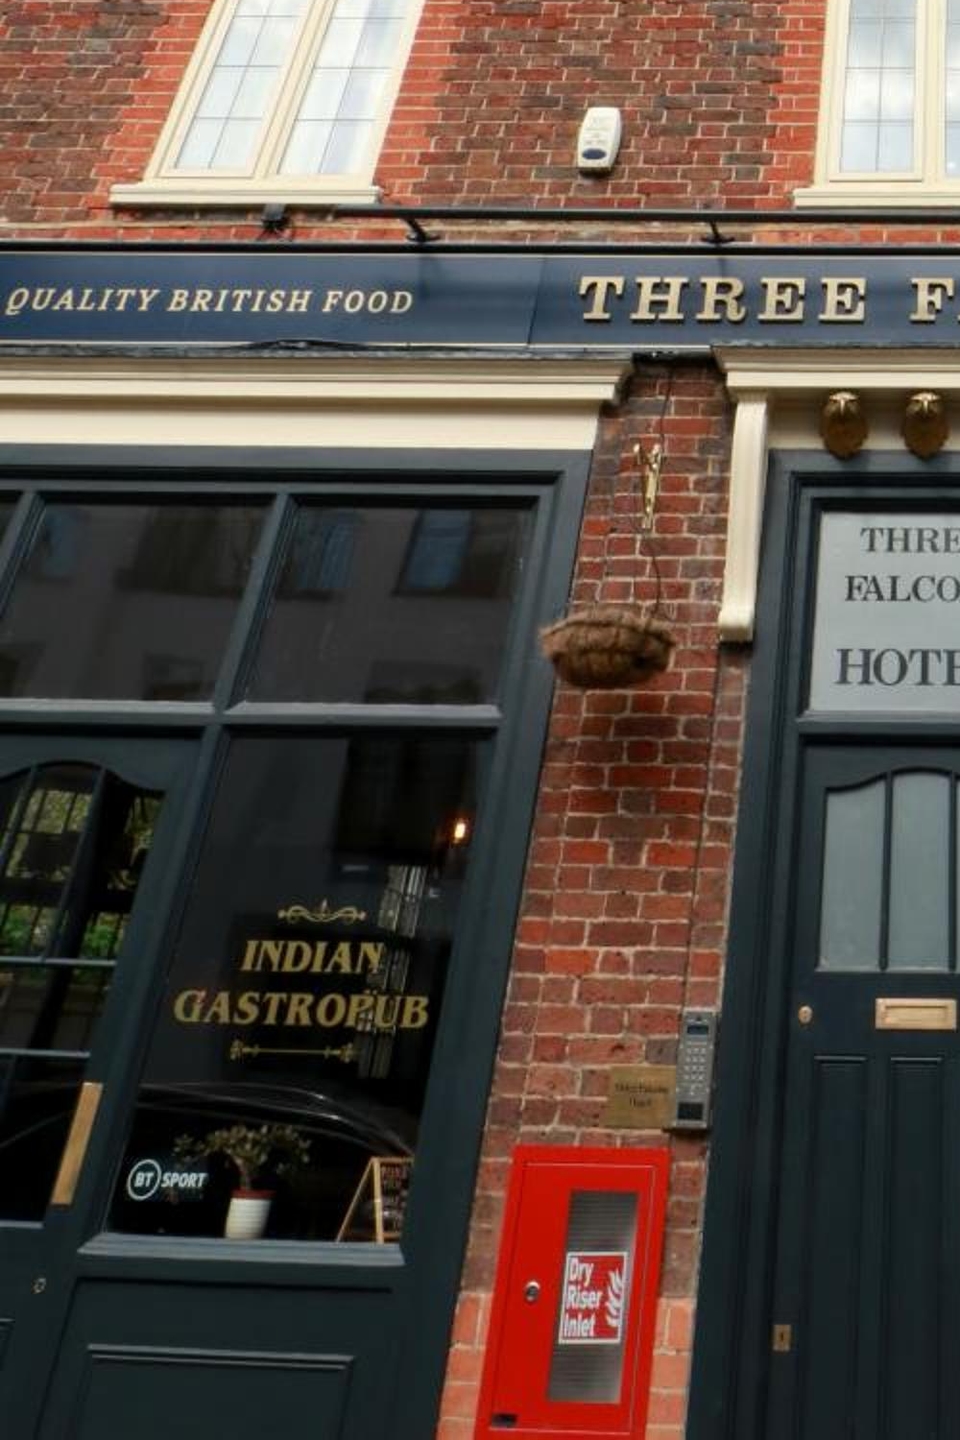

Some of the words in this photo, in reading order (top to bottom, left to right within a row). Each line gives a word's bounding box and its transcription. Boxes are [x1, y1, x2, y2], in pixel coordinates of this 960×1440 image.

[5, 288, 160, 316] QUALITY
[167, 289, 310, 313] BRITISH
[321, 290, 414, 314] FOOD
[578, 274, 868, 324] THREE
[240, 940, 384, 973] INDIAN
[173, 989, 429, 1028] GASTROPUB
[134, 1171, 155, 1188] BT
[160, 1171, 208, 1189] SPORT
[568, 1257, 594, 1288] Dry
[565, 1284, 603, 1310] Riser
[562, 1311, 596, 1338] Inlet
